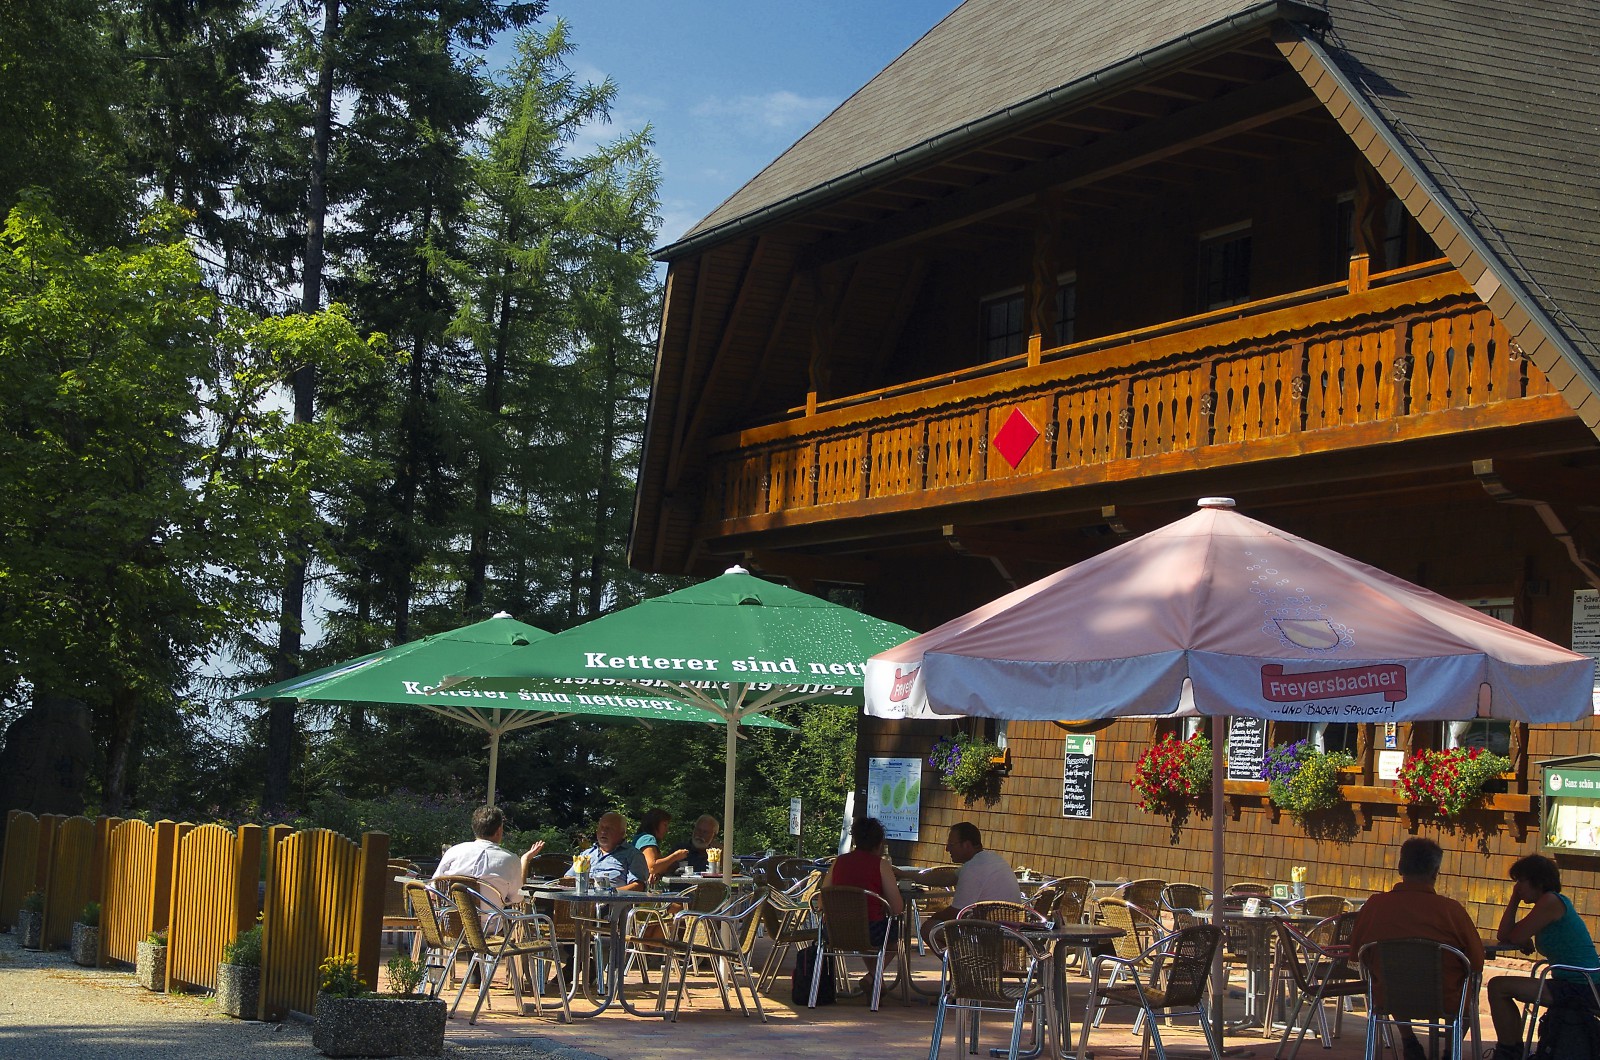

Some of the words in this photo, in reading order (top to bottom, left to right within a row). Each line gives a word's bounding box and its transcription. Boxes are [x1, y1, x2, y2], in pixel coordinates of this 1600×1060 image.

[584, 652, 719, 671] Ketterer
[731, 656, 800, 673] sind
[1270, 671, 1398, 698] Freyersbacher
[1303, 703, 1339, 716] BADEN
